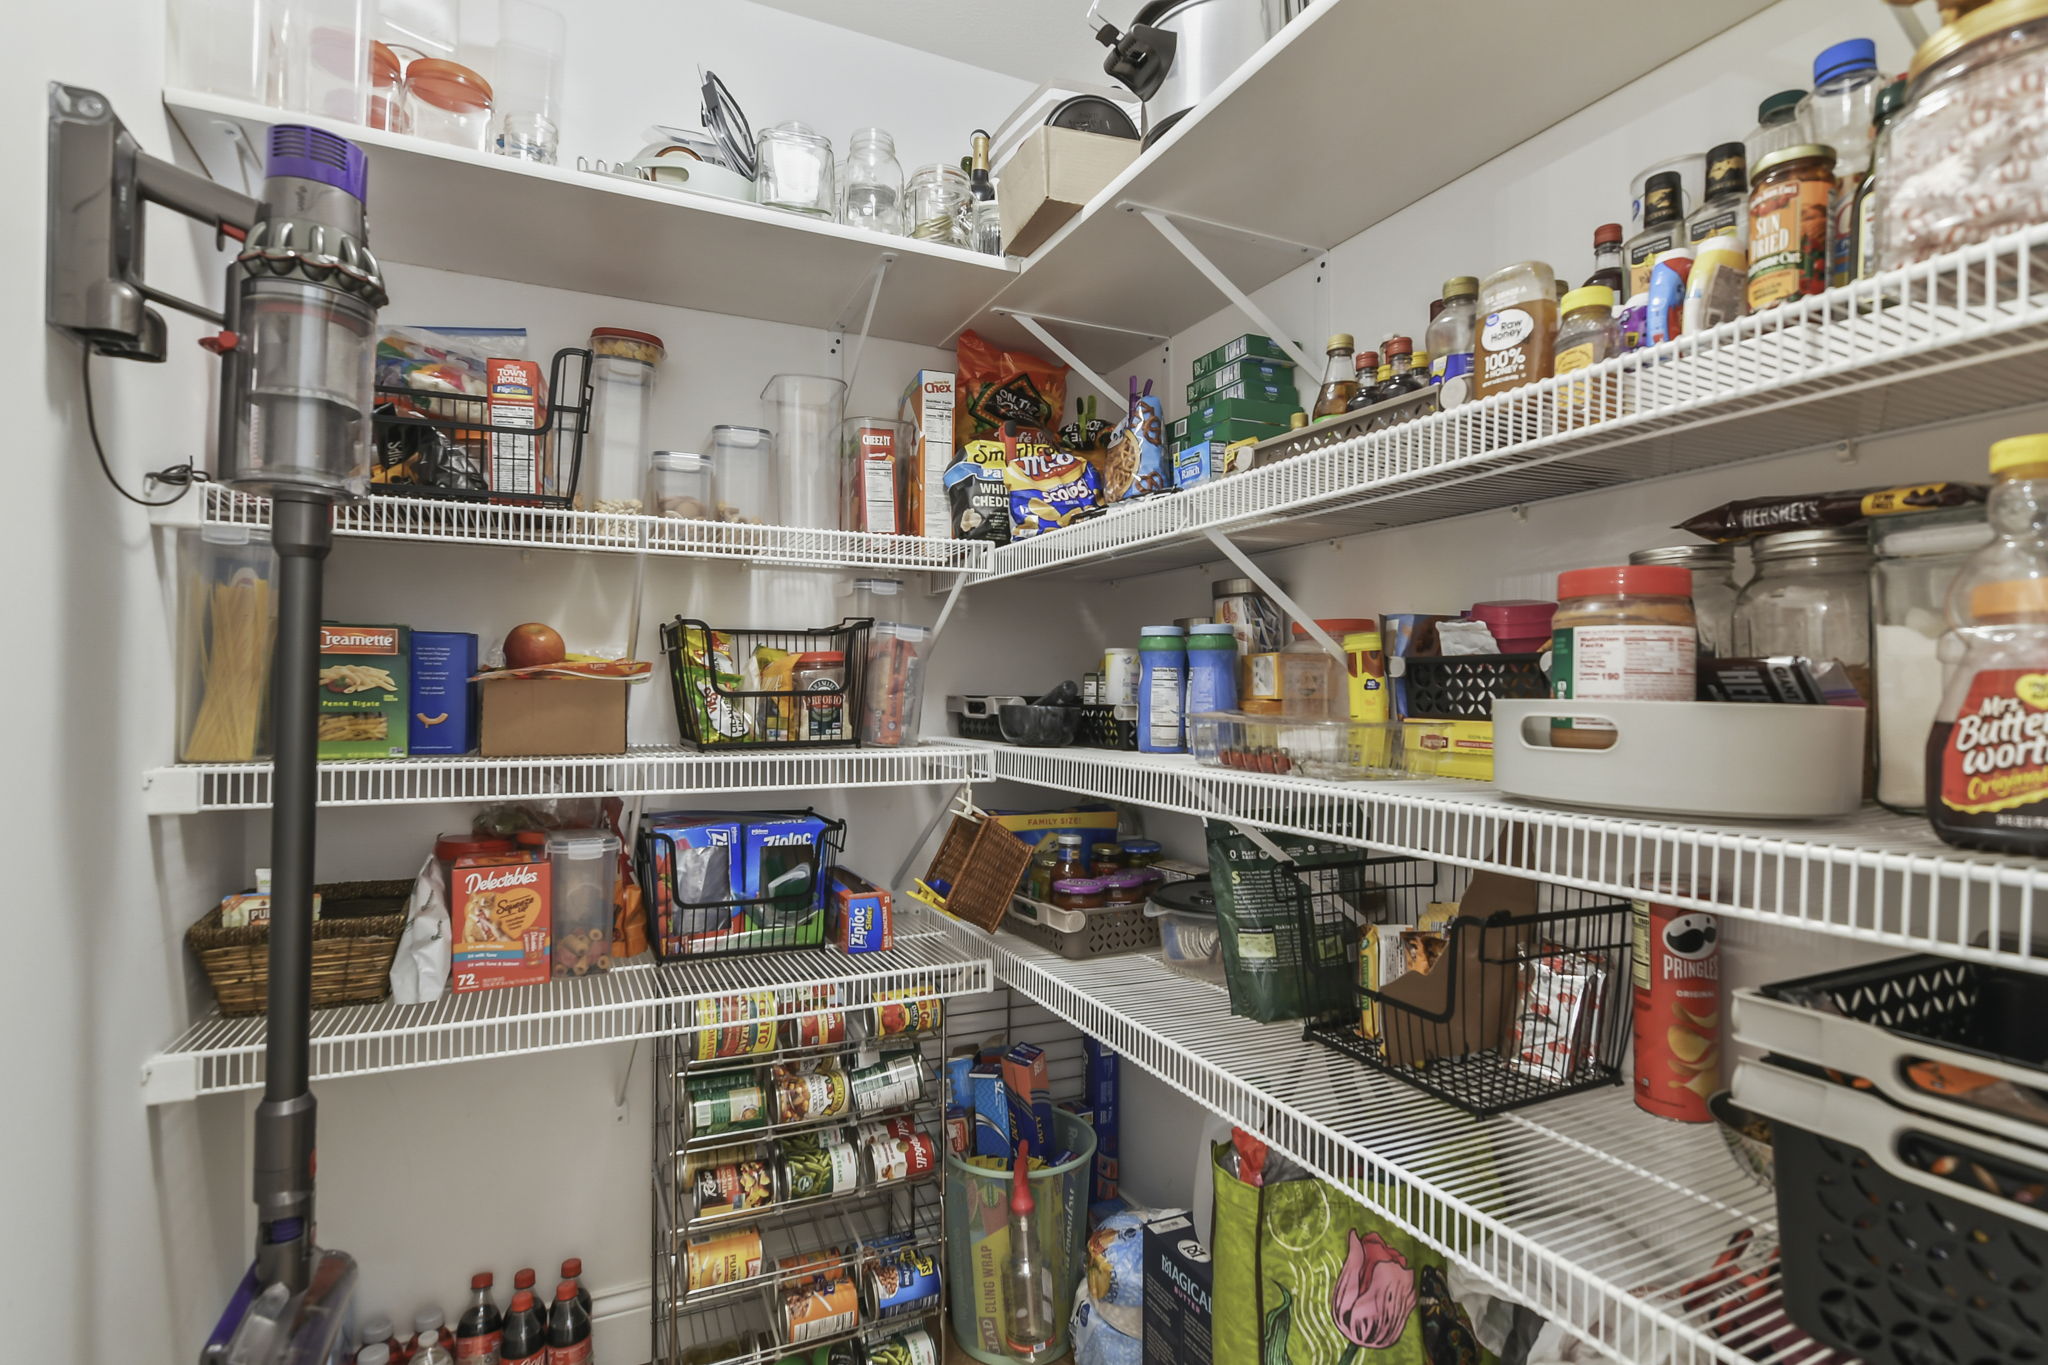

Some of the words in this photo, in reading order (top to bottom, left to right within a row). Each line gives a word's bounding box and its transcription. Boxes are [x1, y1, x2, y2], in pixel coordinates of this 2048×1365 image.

[1756, 214, 1780, 237] SUN
[1490, 327, 1522, 342] Honey
[1501, 320, 1523, 331] Raw
[1485, 346, 1526, 373] 100%
[496, 368, 527, 378] TOWN
[497, 375, 528, 386] HOUSE
[924, 382, 953, 394] Chex
[1181, 465, 1201, 480] Ranch
[980, 482, 1010, 495] WHIT
[972, 495, 1010, 508] CHEDD
[1742, 501, 1819, 528] HERSHEY'S
[1978, 695, 2020, 717] Mrs.
[1028, 816, 1057, 826] FAMILY
[465, 866, 538, 895] Delectables
[851, 907, 868, 945] Ziploc
[865, 905, 873, 931] Slider
[457, 973, 476, 987] 72
[910, 1004, 918, 1027] DICED
[1035, 1116, 1044, 1144] DUTY
[909, 1134, 927, 1169] mpbell's
[980, 1245, 994, 1279] WRAP
[982, 1281, 996, 1314] CLING
